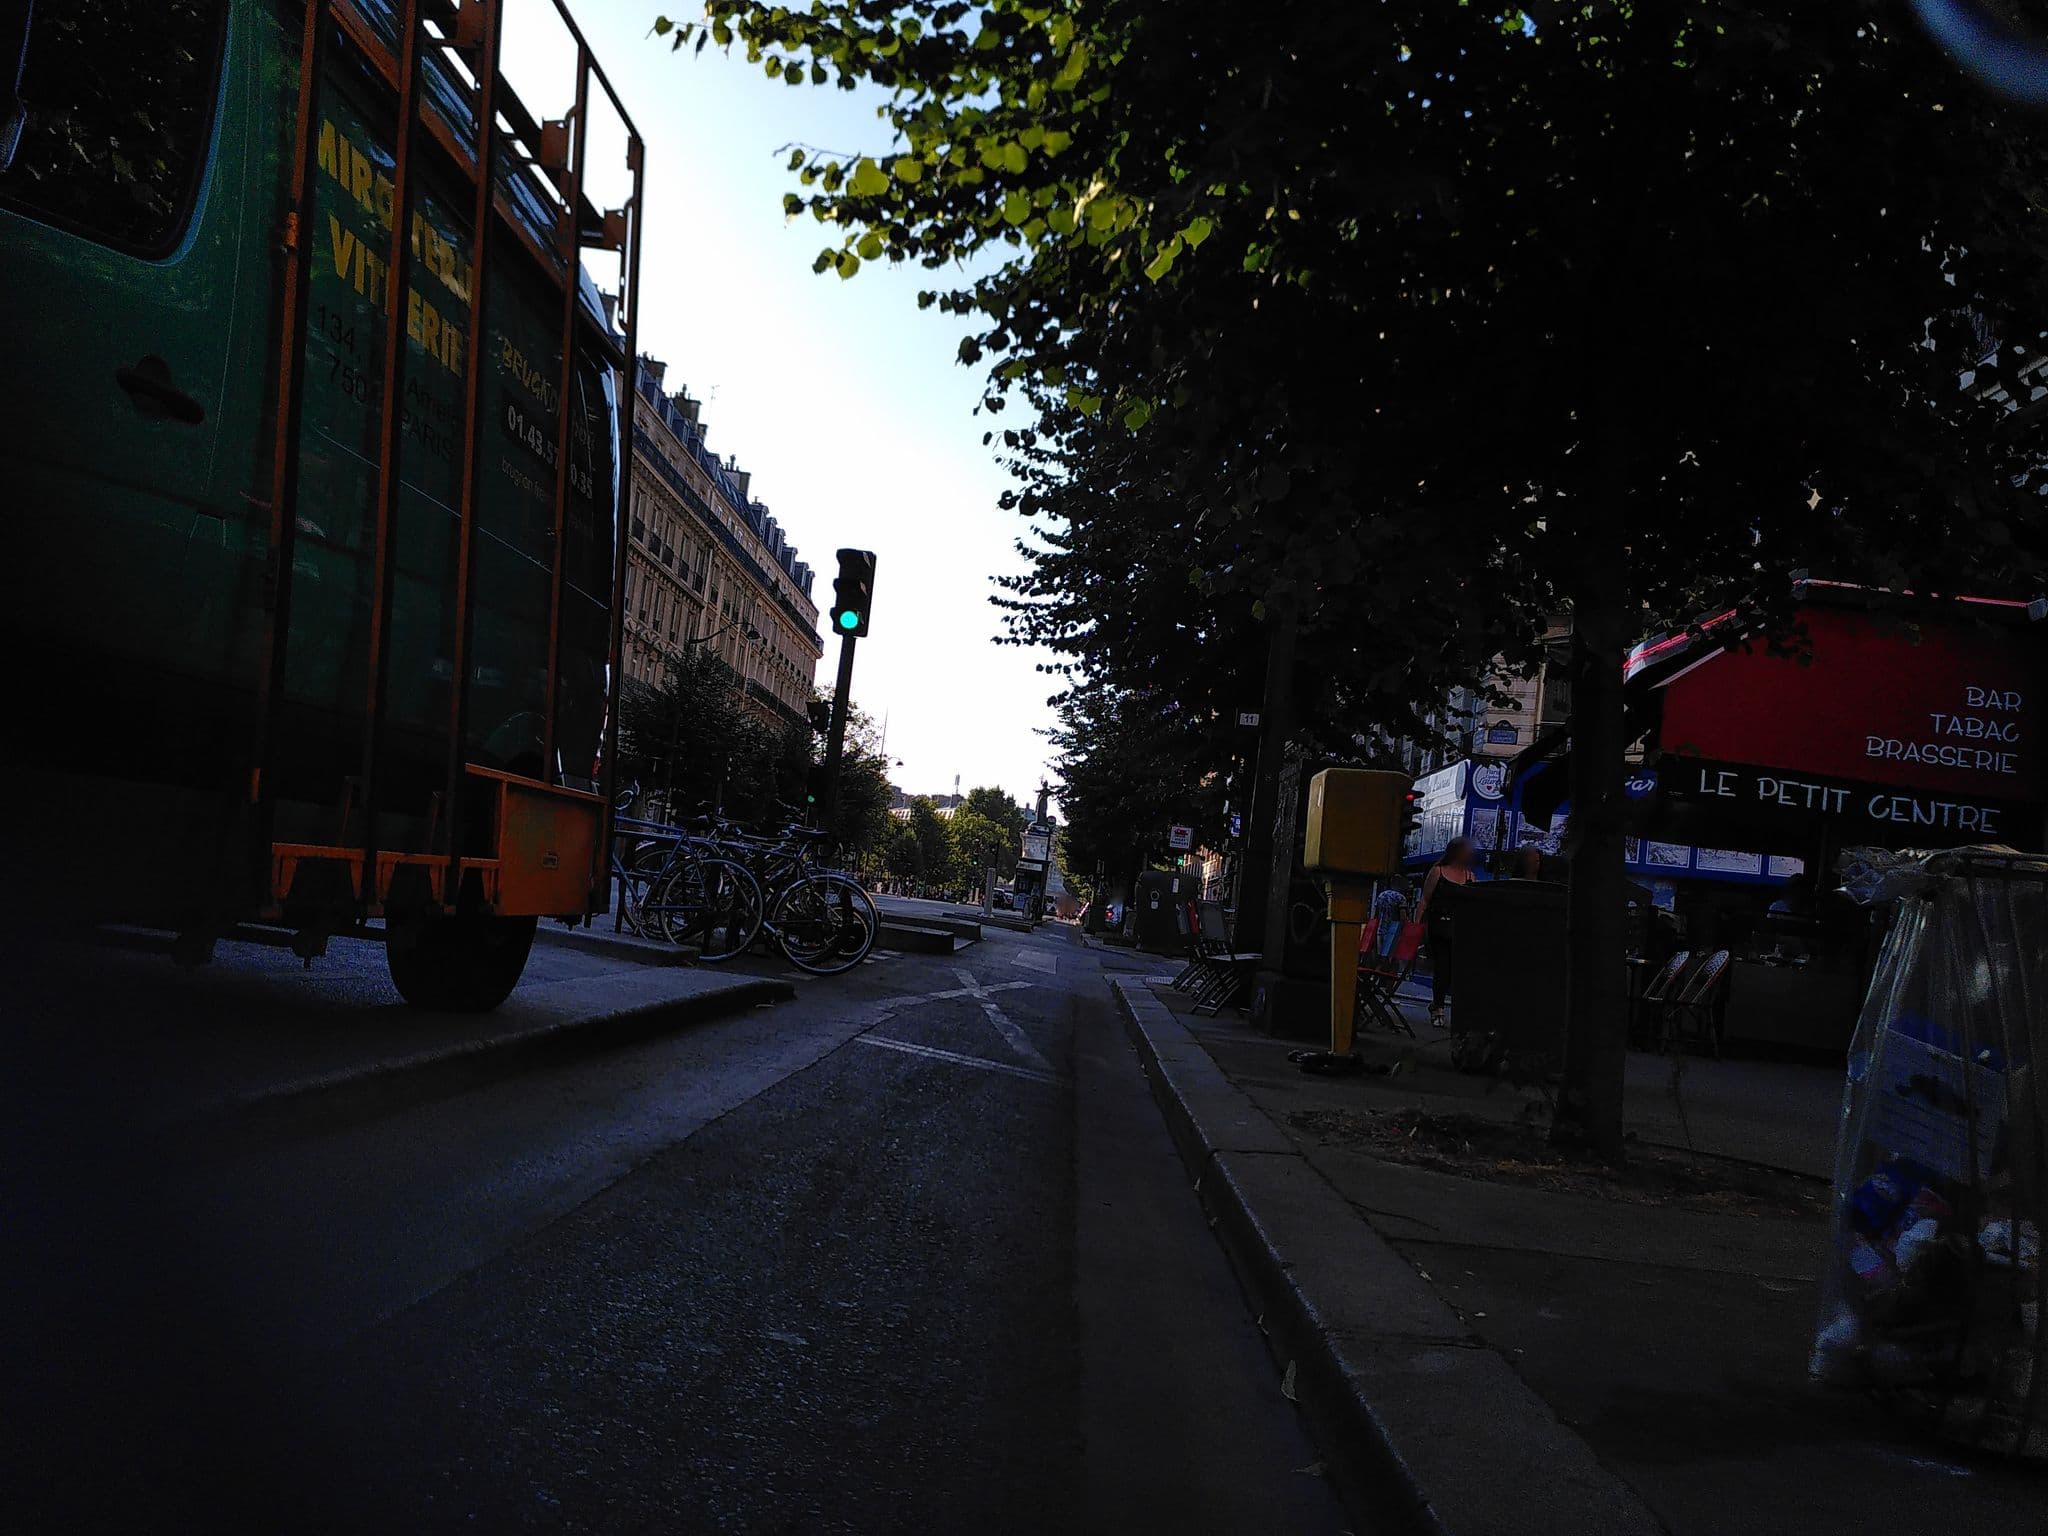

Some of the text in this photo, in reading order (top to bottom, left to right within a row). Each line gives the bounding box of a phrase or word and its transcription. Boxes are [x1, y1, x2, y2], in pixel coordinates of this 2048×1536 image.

[329, 213, 464, 379] VITERIE
[1965, 685, 2023, 713] BAR
[1929, 712, 2021, 744] TABAC
[1865, 735, 2019, 775] BRASSERIE
[1699, 768, 2002, 835] LE PETIT CENTRE
